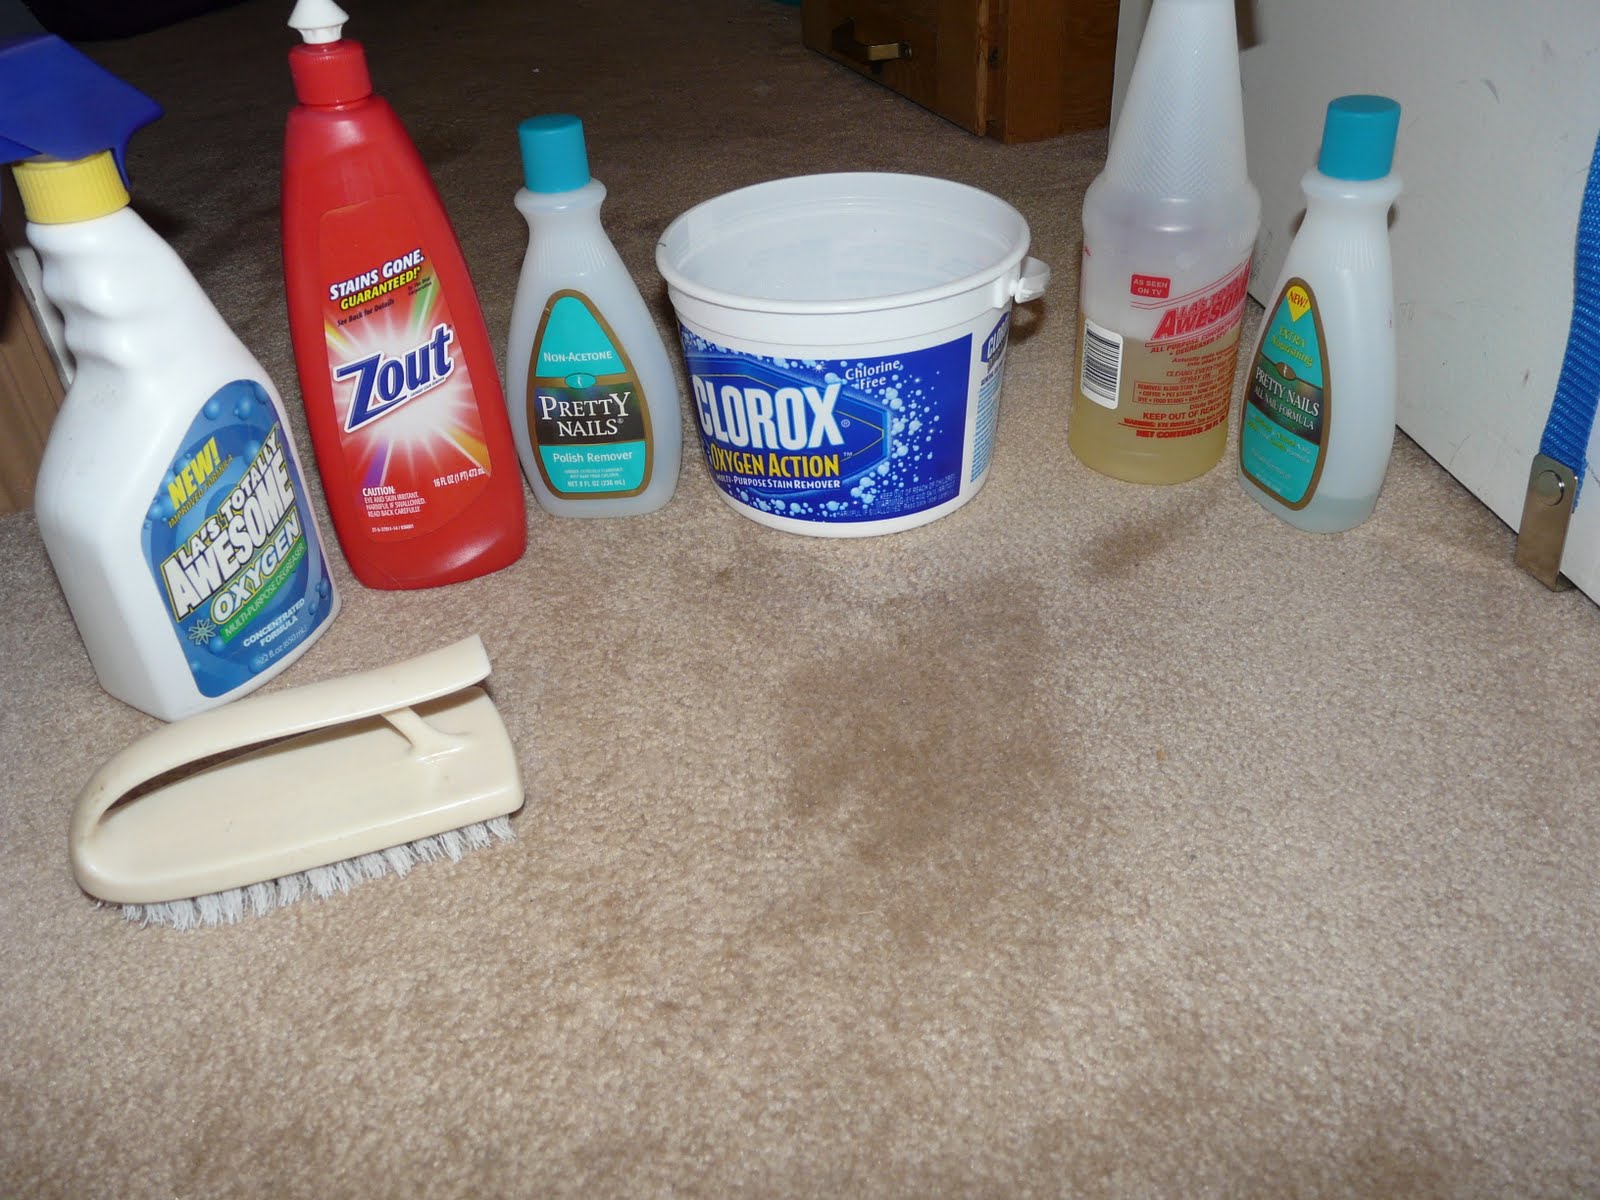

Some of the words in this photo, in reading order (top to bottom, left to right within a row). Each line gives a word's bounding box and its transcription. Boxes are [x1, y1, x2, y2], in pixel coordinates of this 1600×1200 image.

[329, 269, 379, 300] STAINS
[382, 249, 425, 279] GONE.
[1133, 278, 1145, 286] AS
[1146, 280, 1168, 289] SEEN
[1289, 290, 1309, 308] NEW!
[337, 318, 348, 327] See
[348, 311, 364, 323] Back
[364, 307, 374, 318] for
[374, 298, 395, 312] Details
[1166, 338, 1200, 351] PURPOSE
[1175, 336, 1215, 356] DEGREASER
[1280, 327, 1305, 348] EXTRA
[543, 350, 613, 362] NON-ACETONE
[1272, 335, 1313, 368] Nourishing
[334, 324, 453, 432] Zout
[845, 359, 901, 381] Chlorine
[1178, 375, 1200, 383] SPRAY
[860, 376, 888, 390] Free
[1256, 366, 1286, 398] PRETTY
[1286, 389, 1320, 417] NAILS
[538, 391, 632, 420] PRETTY
[691, 373, 845, 450] CLOROX
[1142, 412, 1167, 420] KEEP
[1168, 412, 1186, 420] OUT
[1188, 409, 1200, 418] OF
[1200, 402, 1221, 414] REACH
[1254, 385, 1264, 400] ALL
[1264, 393, 1278, 410] NAIL
[1278, 403, 1314, 431] FORMULA
[1136, 430, 1156, 438] NET
[1156, 426, 1204, 438] CONTENTS:
[553, 452, 584, 464] Polish
[587, 450, 633, 463] Remover
[710, 442, 766, 477] OXYGEN
[768, 452, 840, 479] ACTION
[168, 435, 220, 511] NEW!
[433, 478, 440, 488] 16
[440, 476, 448, 486] FL
[447, 474, 455, 484] OZ
[468, 468, 478, 478] 473
[168, 488, 204, 529] IMPROVED
[204, 453, 233, 491] FORMULA
[362, 486, 396, 497] CAUTION:
[767, 480, 793, 489] STAIN
[794, 480, 841, 490] REMOVER
[880, 491, 893, 500] KEEP
[894, 488, 904, 498] OUT
[912, 484, 928, 493] REACH
[180, 516, 221, 567] LA'S
[220, 427, 281, 521] TOTALLY
[364, 496, 374, 504] EYE
[384, 494, 397, 502] SKIN
[366, 502, 390, 510] HARMFUL
[906, 495, 914, 503] EYE
[380, 509, 394, 517] BACK
[161, 446, 296, 621] AWESOME
[212, 511, 302, 624] OXYGEN
[224, 580, 276, 637] MULTI-PURPOSE
[276, 542, 305, 587] DEGREASER
[243, 598, 306, 648] CONCENTRATED
[260, 614, 299, 648] FORMULA
